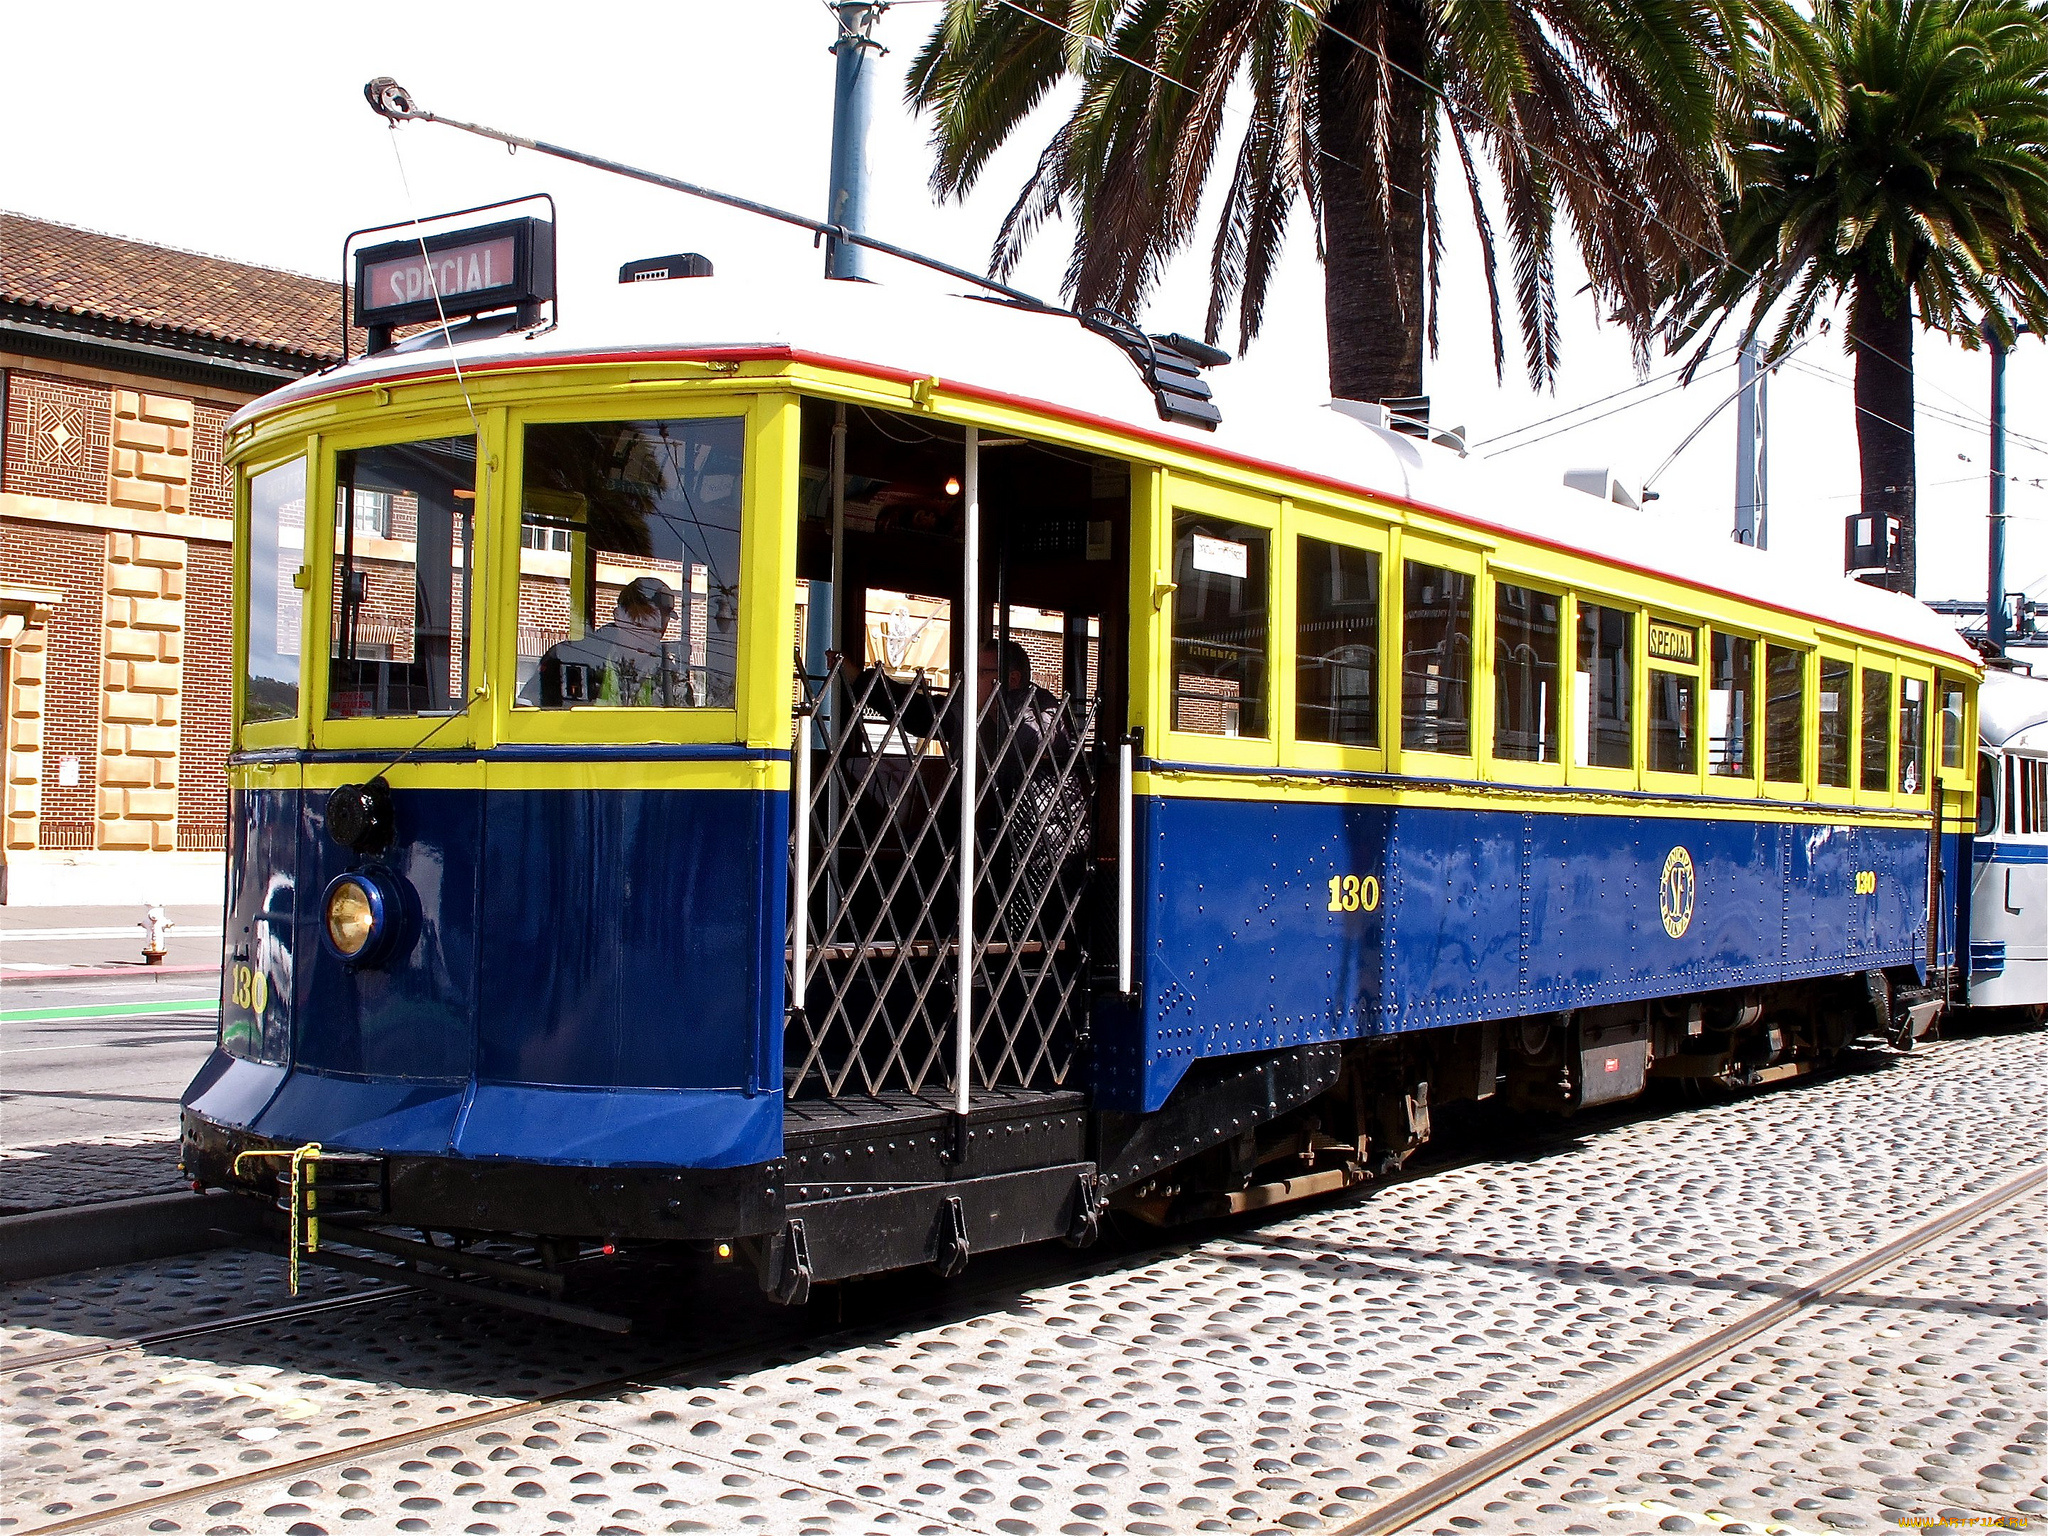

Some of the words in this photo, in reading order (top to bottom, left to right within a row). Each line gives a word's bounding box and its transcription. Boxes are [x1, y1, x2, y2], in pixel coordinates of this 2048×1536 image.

[390, 250, 502, 305] SPECIAL
[1650, 628, 1690, 659] SPECIAL
[1327, 874, 1379, 912] 130
[1855, 870, 1876, 895] 130
[232, 964, 268, 1014] 130
